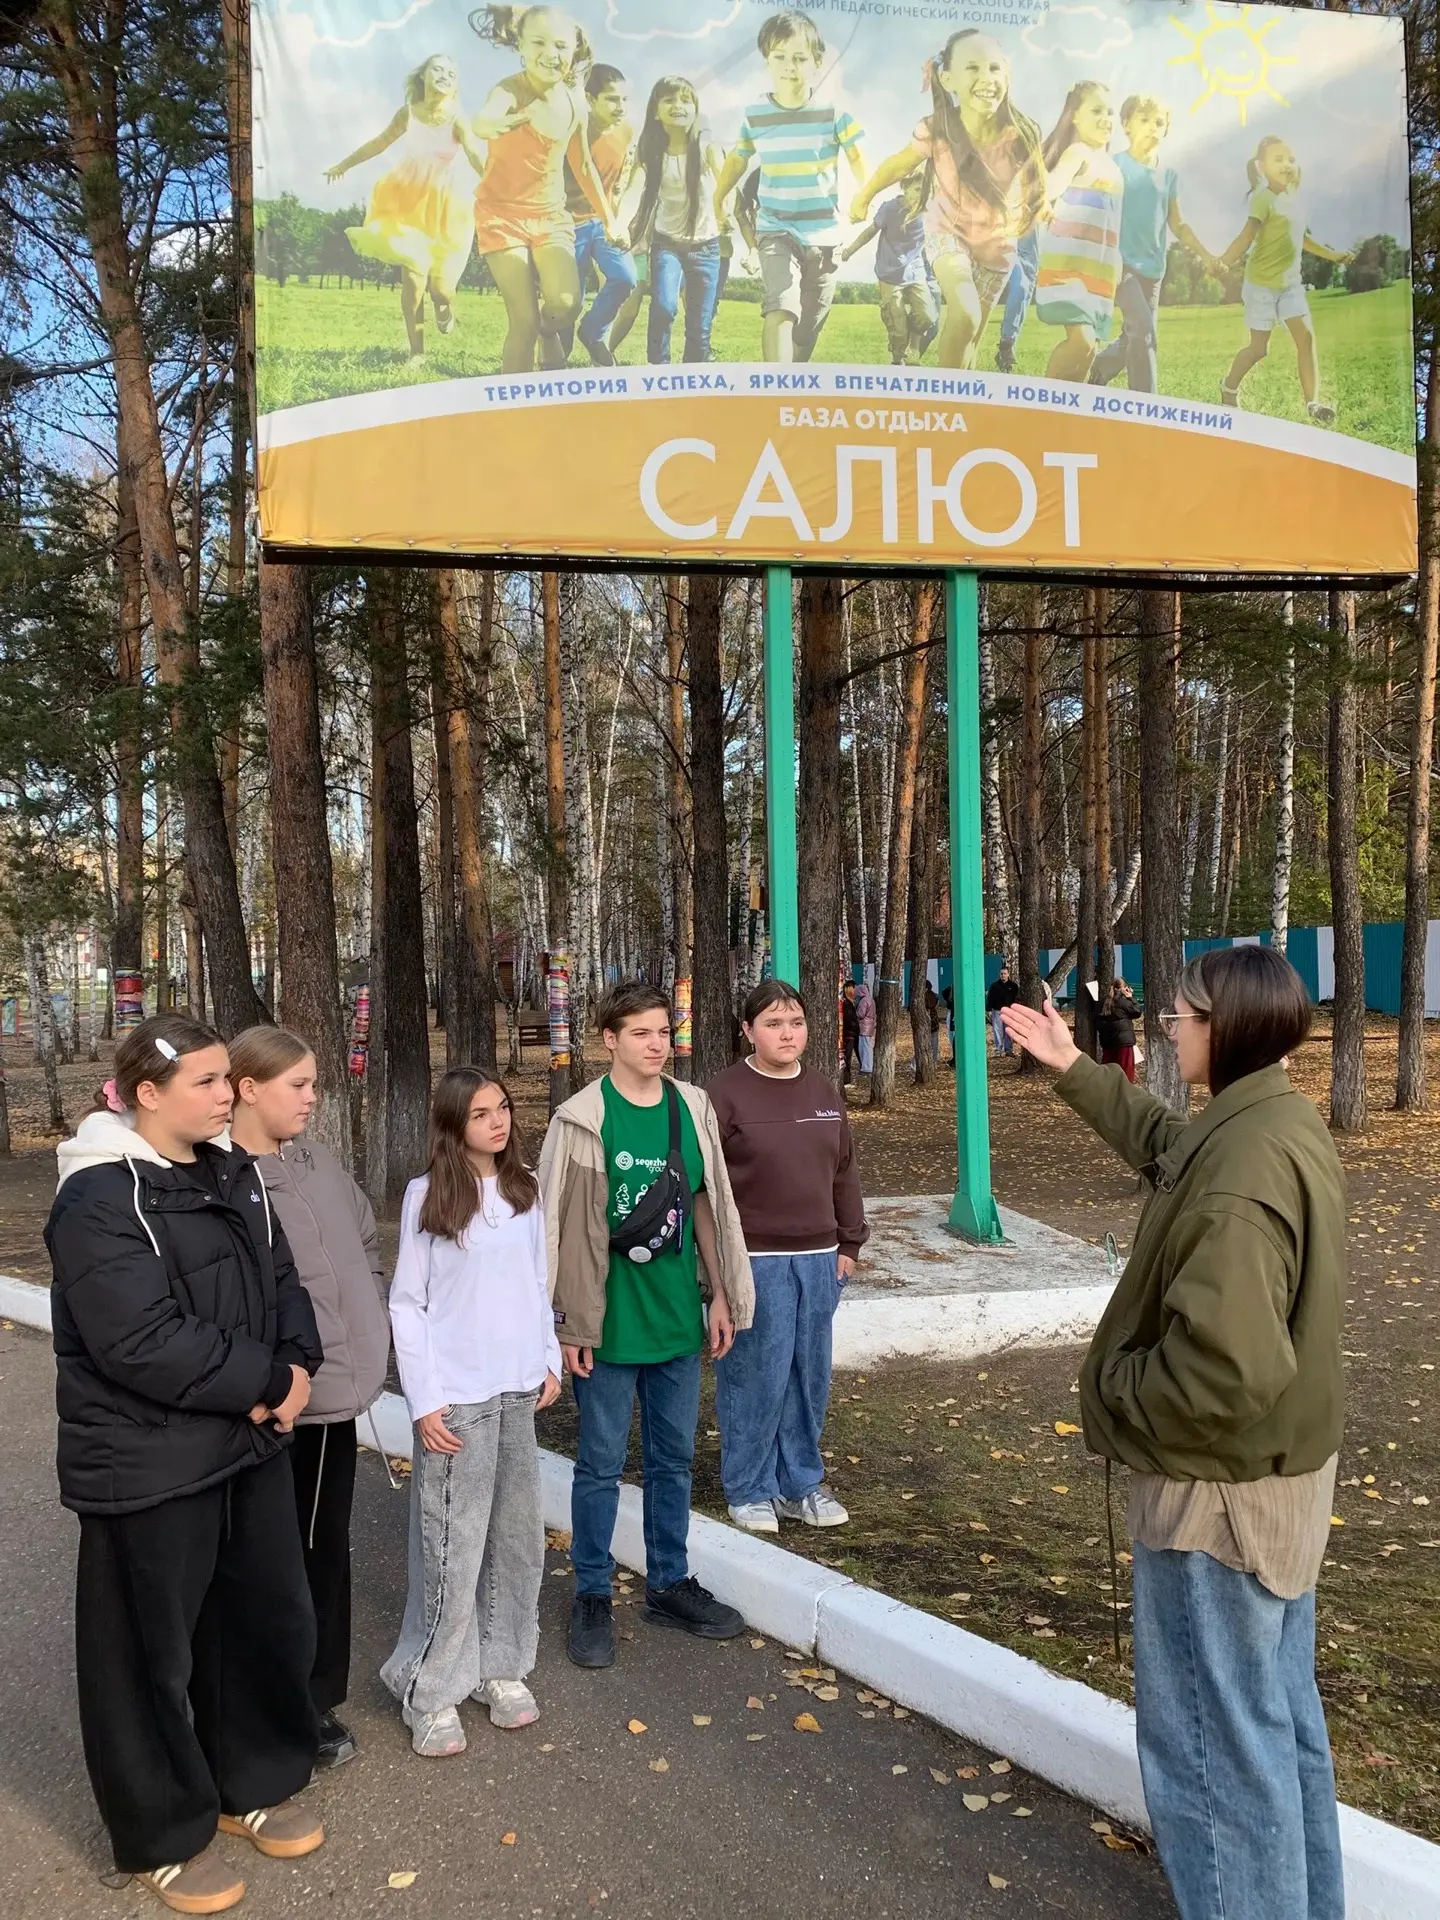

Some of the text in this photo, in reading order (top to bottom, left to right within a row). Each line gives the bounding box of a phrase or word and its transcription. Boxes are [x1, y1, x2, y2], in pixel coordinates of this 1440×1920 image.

[831, 2, 958, 20] ПЕДАГОГИЧЕСКИЙ
[1018, 0, 1050, 11] КРАЯ
[485, 374, 1233, 431] ТЕРРИТОРИЯ УСПЕХА, ЯРКИХ ВПЕЧАТЛЕНИЙ, НОВЫХ ДОСТИЖЕНИЙ
[779, 406, 968, 434] БАЗА ОТДЫХА
[639, 437, 1098, 548] САЛЮТ
